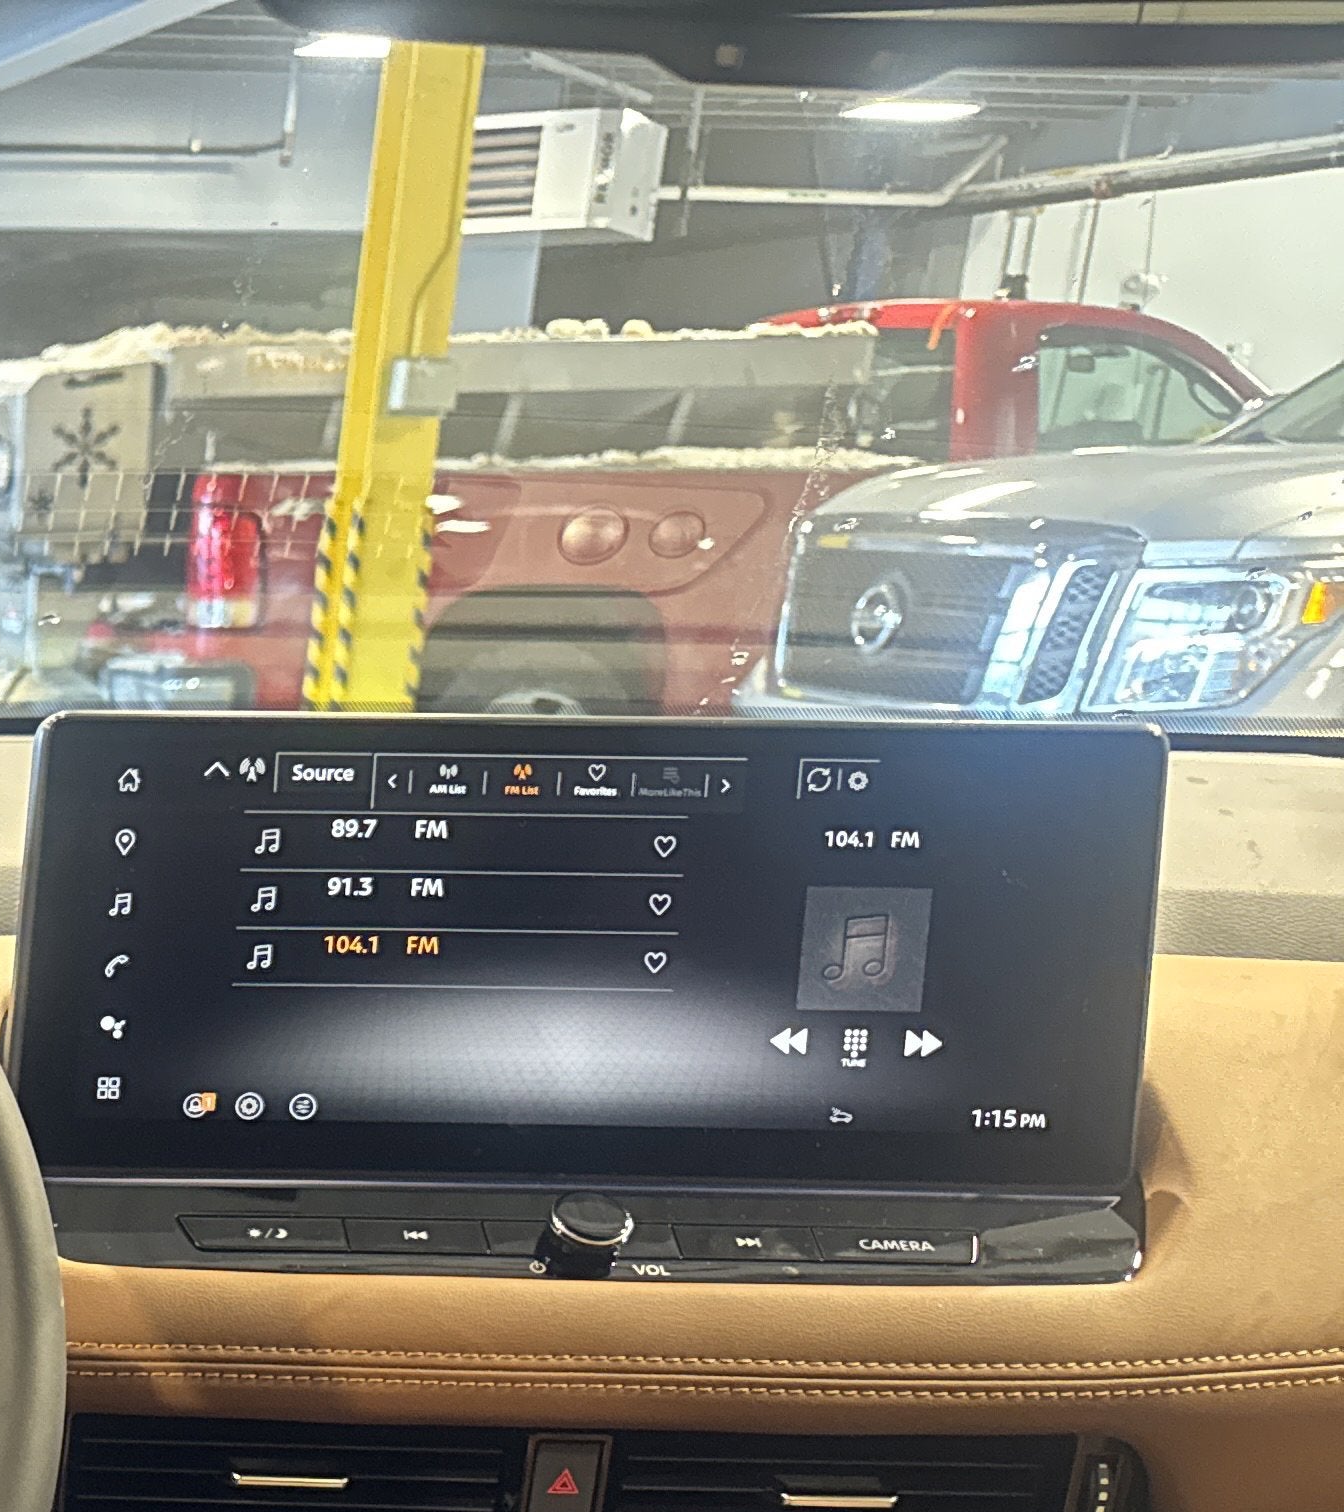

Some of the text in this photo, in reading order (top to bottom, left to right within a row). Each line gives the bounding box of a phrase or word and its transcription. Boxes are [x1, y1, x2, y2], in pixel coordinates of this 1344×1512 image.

[292, 764, 355, 785] Source
[429, 784, 467, 796] AM List
[504, 785, 539, 797] FM List
[573, 786, 618, 797] Favorites
[331, 819, 448, 840] 89.7 FM
[824, 830, 921, 850] 104.1 FM
[327, 877, 444, 898] 91.3 FM
[323, 935, 440, 956] 104.1 FM
[858, 1237, 936, 1254] CAMERA
[631, 1263, 671, 1277] VOL
